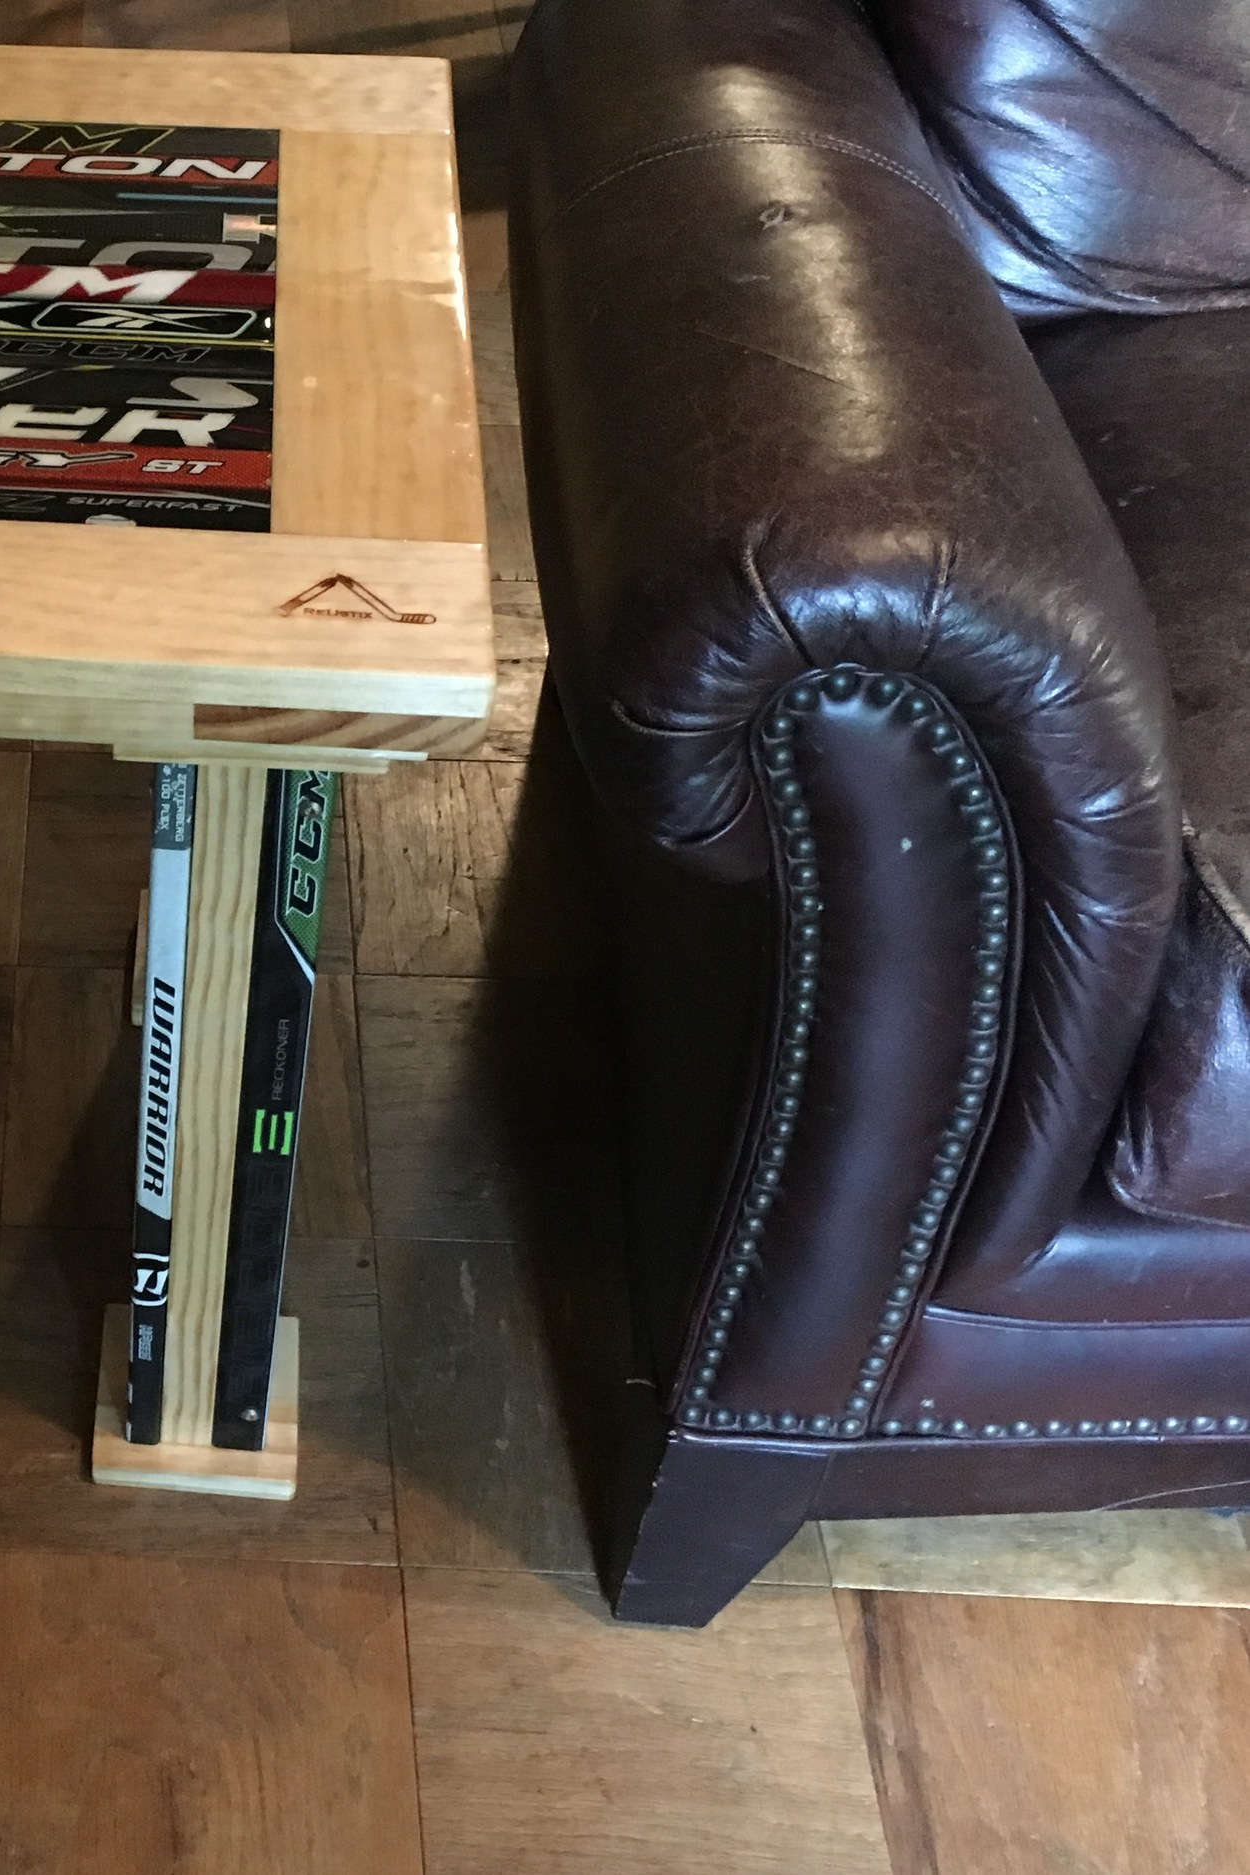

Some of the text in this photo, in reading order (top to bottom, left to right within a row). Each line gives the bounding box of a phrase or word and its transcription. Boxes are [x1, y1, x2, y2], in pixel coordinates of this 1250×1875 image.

[140, 458, 225, 475] ST
[65, 496, 244, 513] SUPERFAST
[161, 778, 171, 800] 100
[271, 1018, 291, 1101] RECKONER
[143, 976, 176, 1198] WARRIOR
